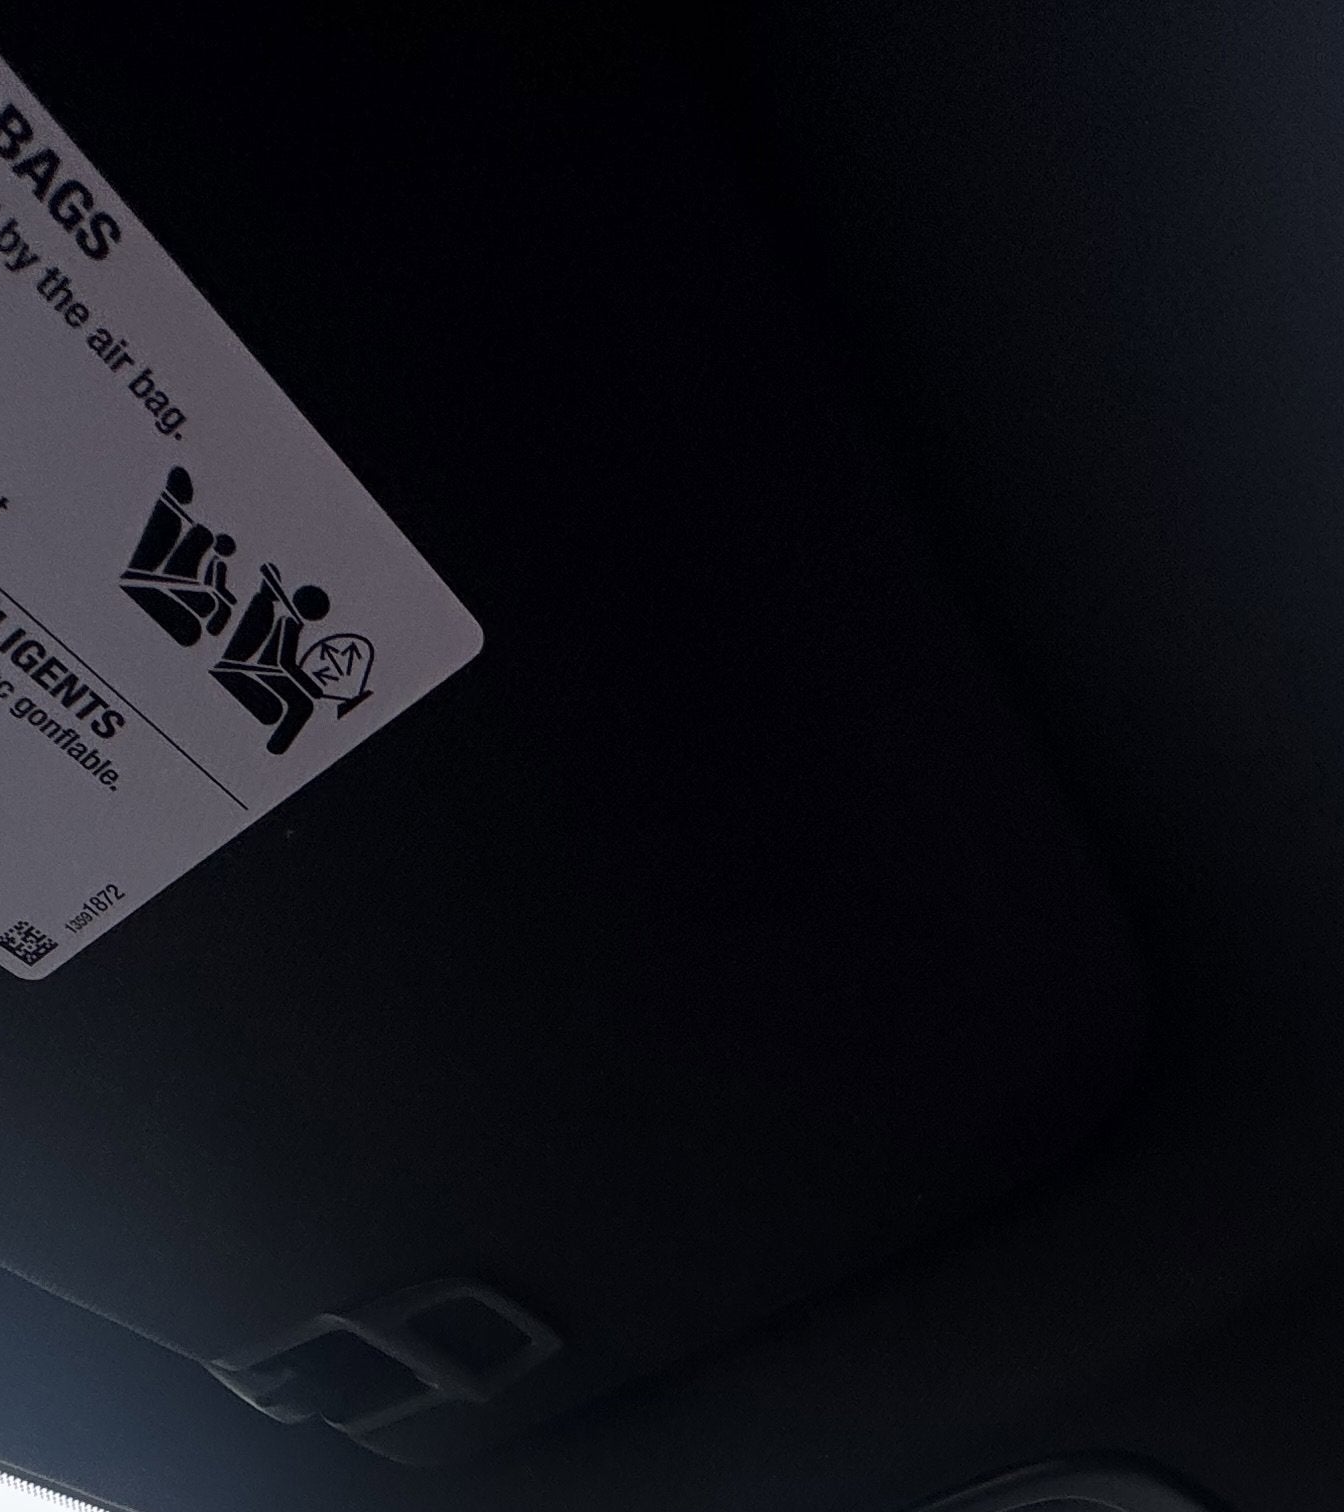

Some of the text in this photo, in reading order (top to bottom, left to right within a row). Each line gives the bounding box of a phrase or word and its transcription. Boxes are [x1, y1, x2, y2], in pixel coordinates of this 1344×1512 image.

[36, 267, 90, 329] the
[86, 327, 135, 372] air
[127, 367, 187, 441] bag.
[9, 697, 120, 792] gonflable.
[64, 883, 126, 934] 13591872
